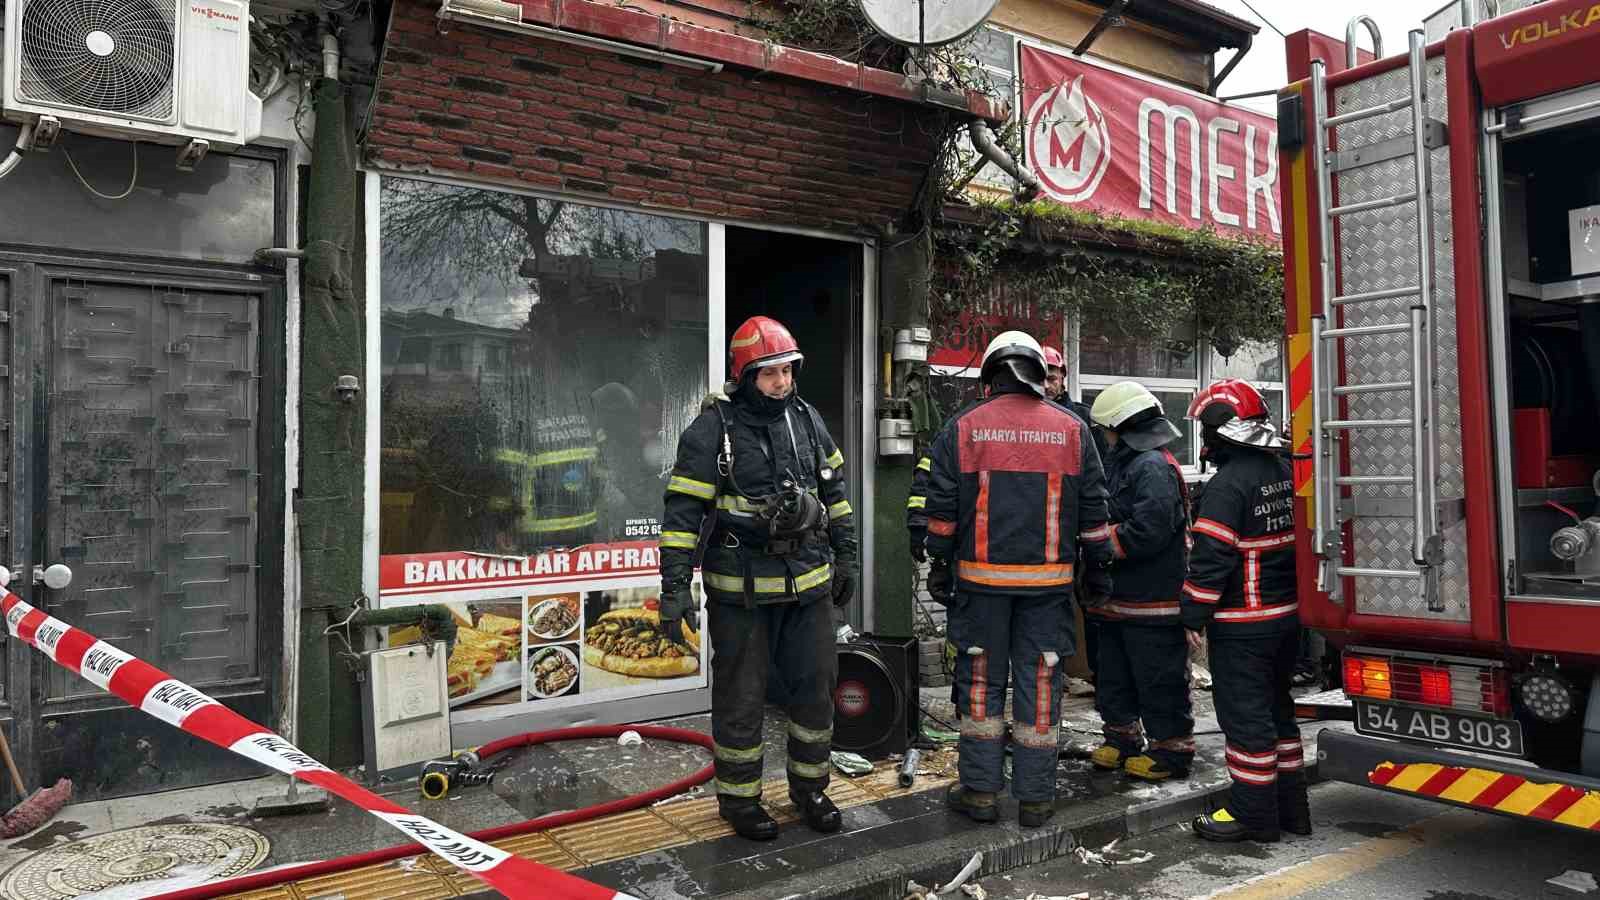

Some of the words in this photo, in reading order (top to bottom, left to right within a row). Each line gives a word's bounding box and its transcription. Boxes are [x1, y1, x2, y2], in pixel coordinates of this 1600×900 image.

[971, 429, 1017, 443] SAKARYA
[1019, 428, 1066, 446] İTFAİYESİ
[625, 525, 650, 536] 0542
[404, 552, 570, 584] BAKKALLAR
[151, 682, 184, 703] HAZ
[170, 693, 210, 712] MAT
[1367, 704, 1399, 731] 54
[1407, 711, 1451, 740] AB
[1458, 718, 1512, 749] 903
[252, 736, 283, 752] HAZ
[280, 750, 323, 769] MAT
[396, 819, 451, 841] HAZ
[432, 842, 495, 866] MAT
